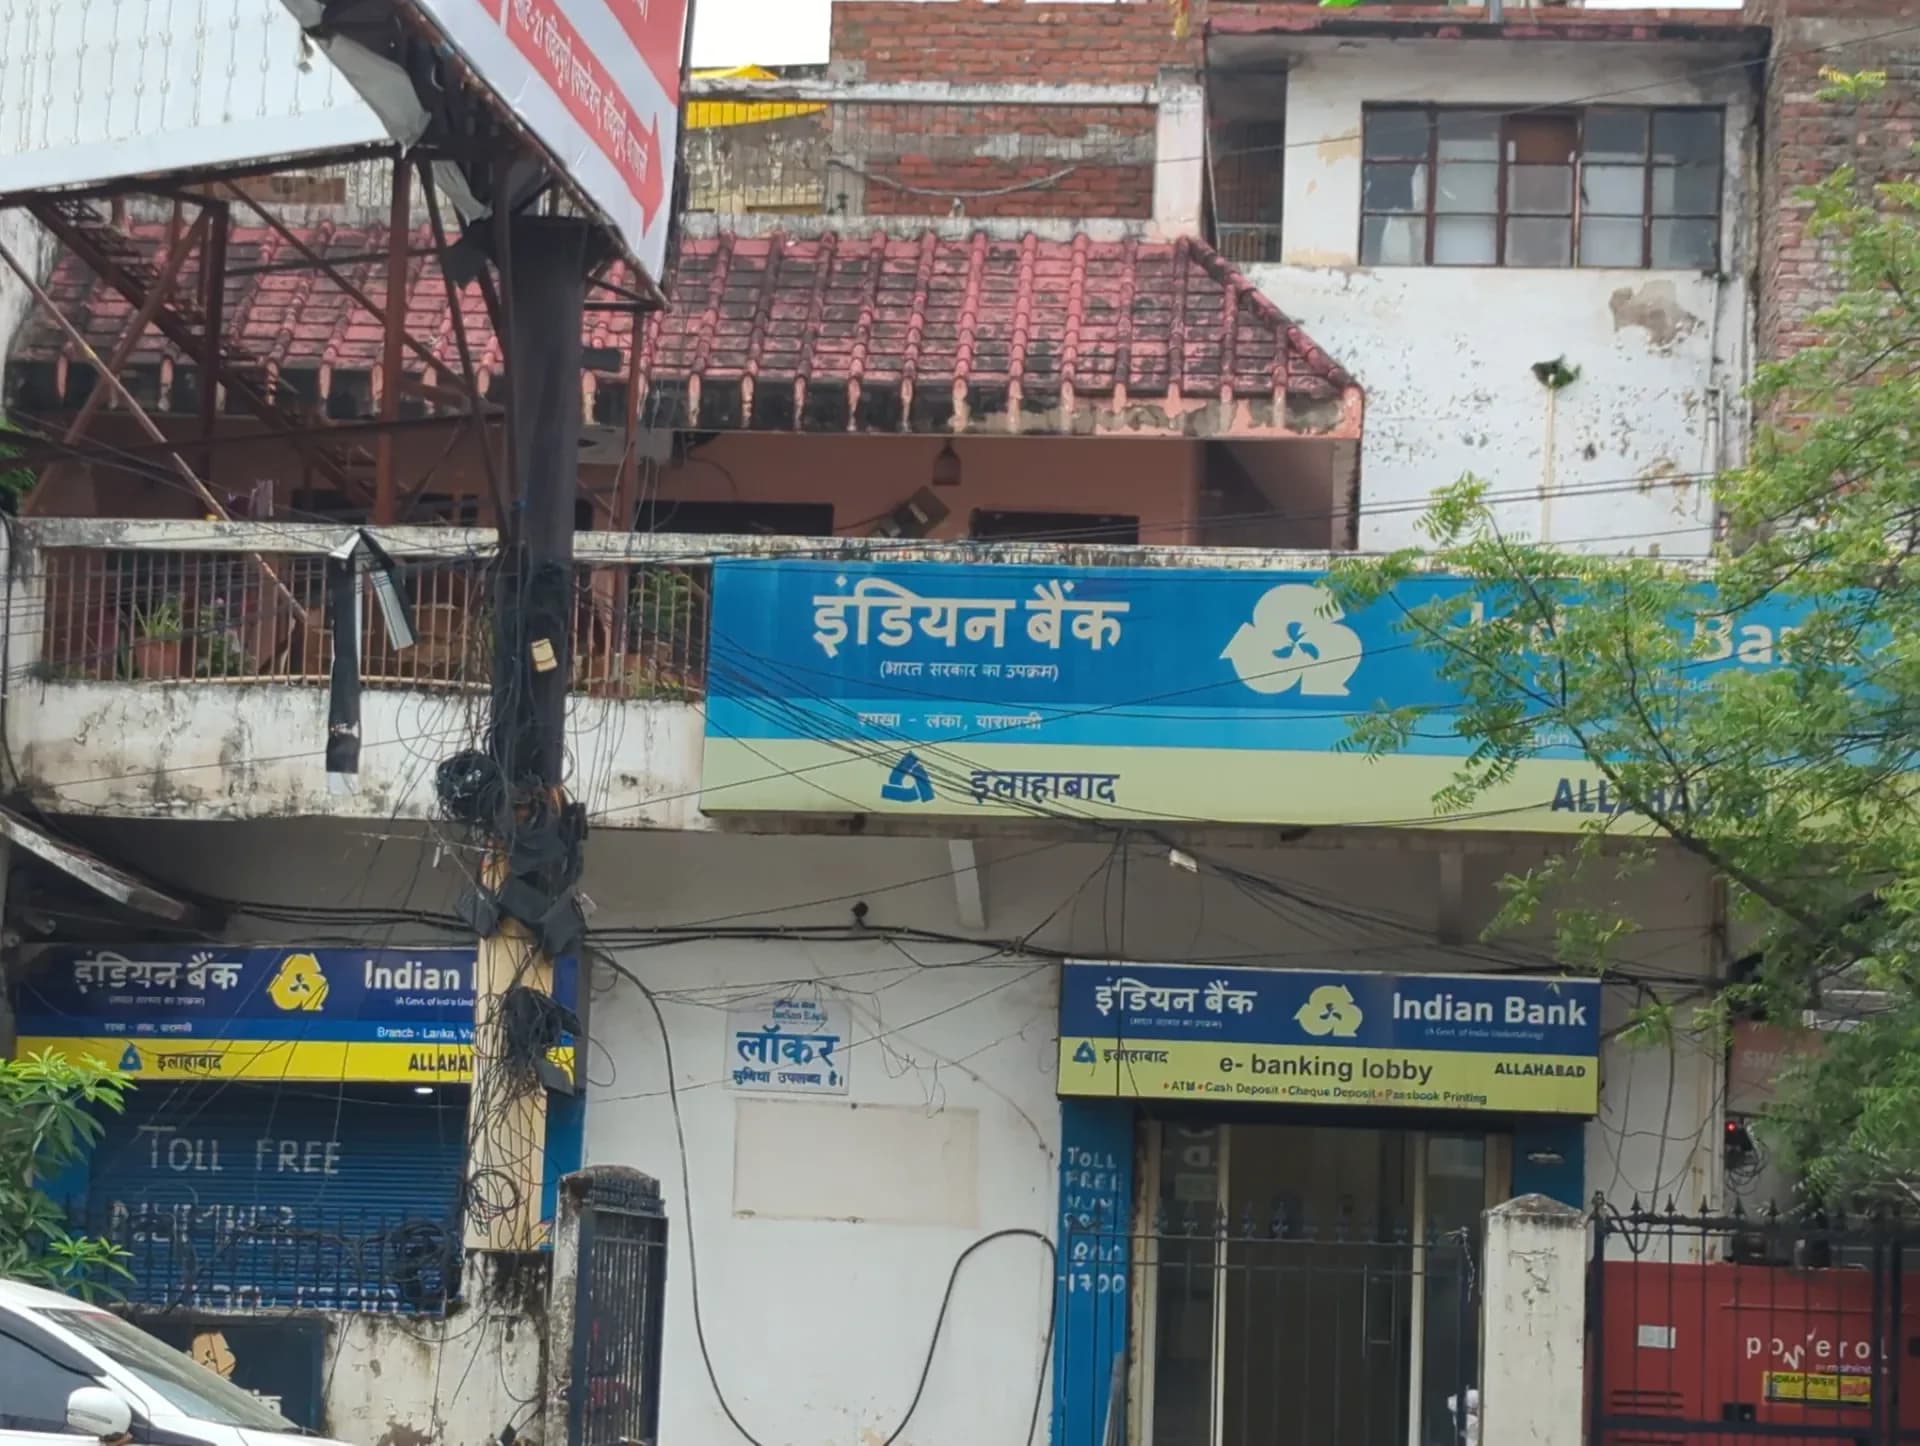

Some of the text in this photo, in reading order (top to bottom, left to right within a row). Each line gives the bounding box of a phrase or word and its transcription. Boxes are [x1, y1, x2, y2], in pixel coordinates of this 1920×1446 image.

[813, 576, 1130, 658] इंडियन बैंक
[879, 660, 1059, 682] (भारत सरकार का उपक्रम)
[969, 769, 1120, 804] इलाहाबाद
[73, 951, 243, 993] इंडियन बैंक
[365, 960, 460, 991] Indian
[1096, 976, 1257, 1016] इंडियन बैंक
[1393, 992, 1587, 1026] Indian Bank
[377, 1026, 414, 1038] Branch
[736, 1024, 840, 1067] लॉकर
[157, 1053, 223, 1072] इलाहाबाद
[1251, 1054, 1352, 1082] banking
[1362, 1058, 1432, 1085] lobby
[1494, 1062, 1586, 1078] ALLAHABAD
[1171, 1081, 1487, 1104] ATM Cash Deposit Cheque Deposit Passbook Printing
[139, 1126, 341, 1174] TOLL FREE
[1068, 1147, 1116, 1168] TOLL
